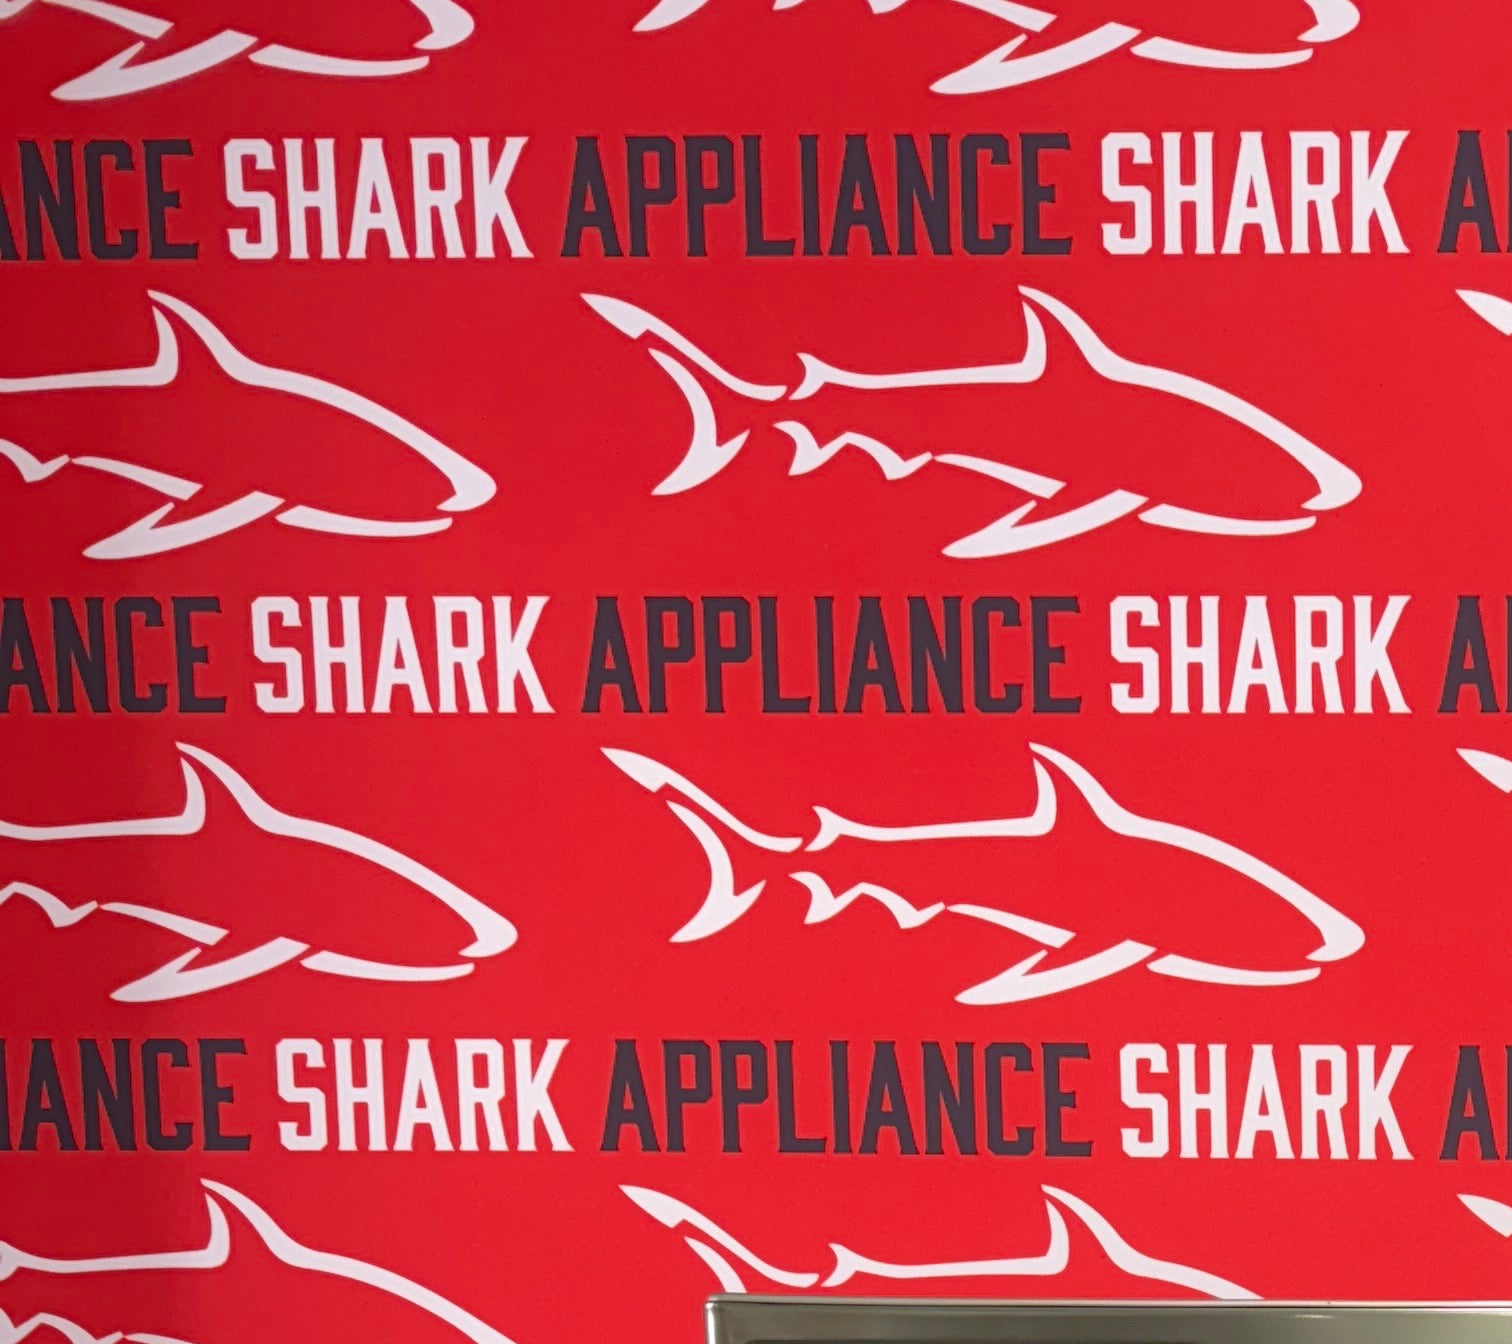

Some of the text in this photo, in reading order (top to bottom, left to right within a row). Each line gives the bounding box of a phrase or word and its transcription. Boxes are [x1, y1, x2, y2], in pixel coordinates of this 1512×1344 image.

[223, 136, 534, 260] SHARK
[561, 134, 1071, 257] APPLIANCE
[1101, 130, 1410, 255] SHARK
[251, 596, 555, 714] SHARK
[582, 597, 1080, 714] APPLIANCE
[1109, 595, 1412, 714] SHARK
[275, 1038, 575, 1152] SHARK
[601, 1040, 1092, 1156] APPLIANCE
[1119, 1043, 1414, 1160] SHARK
